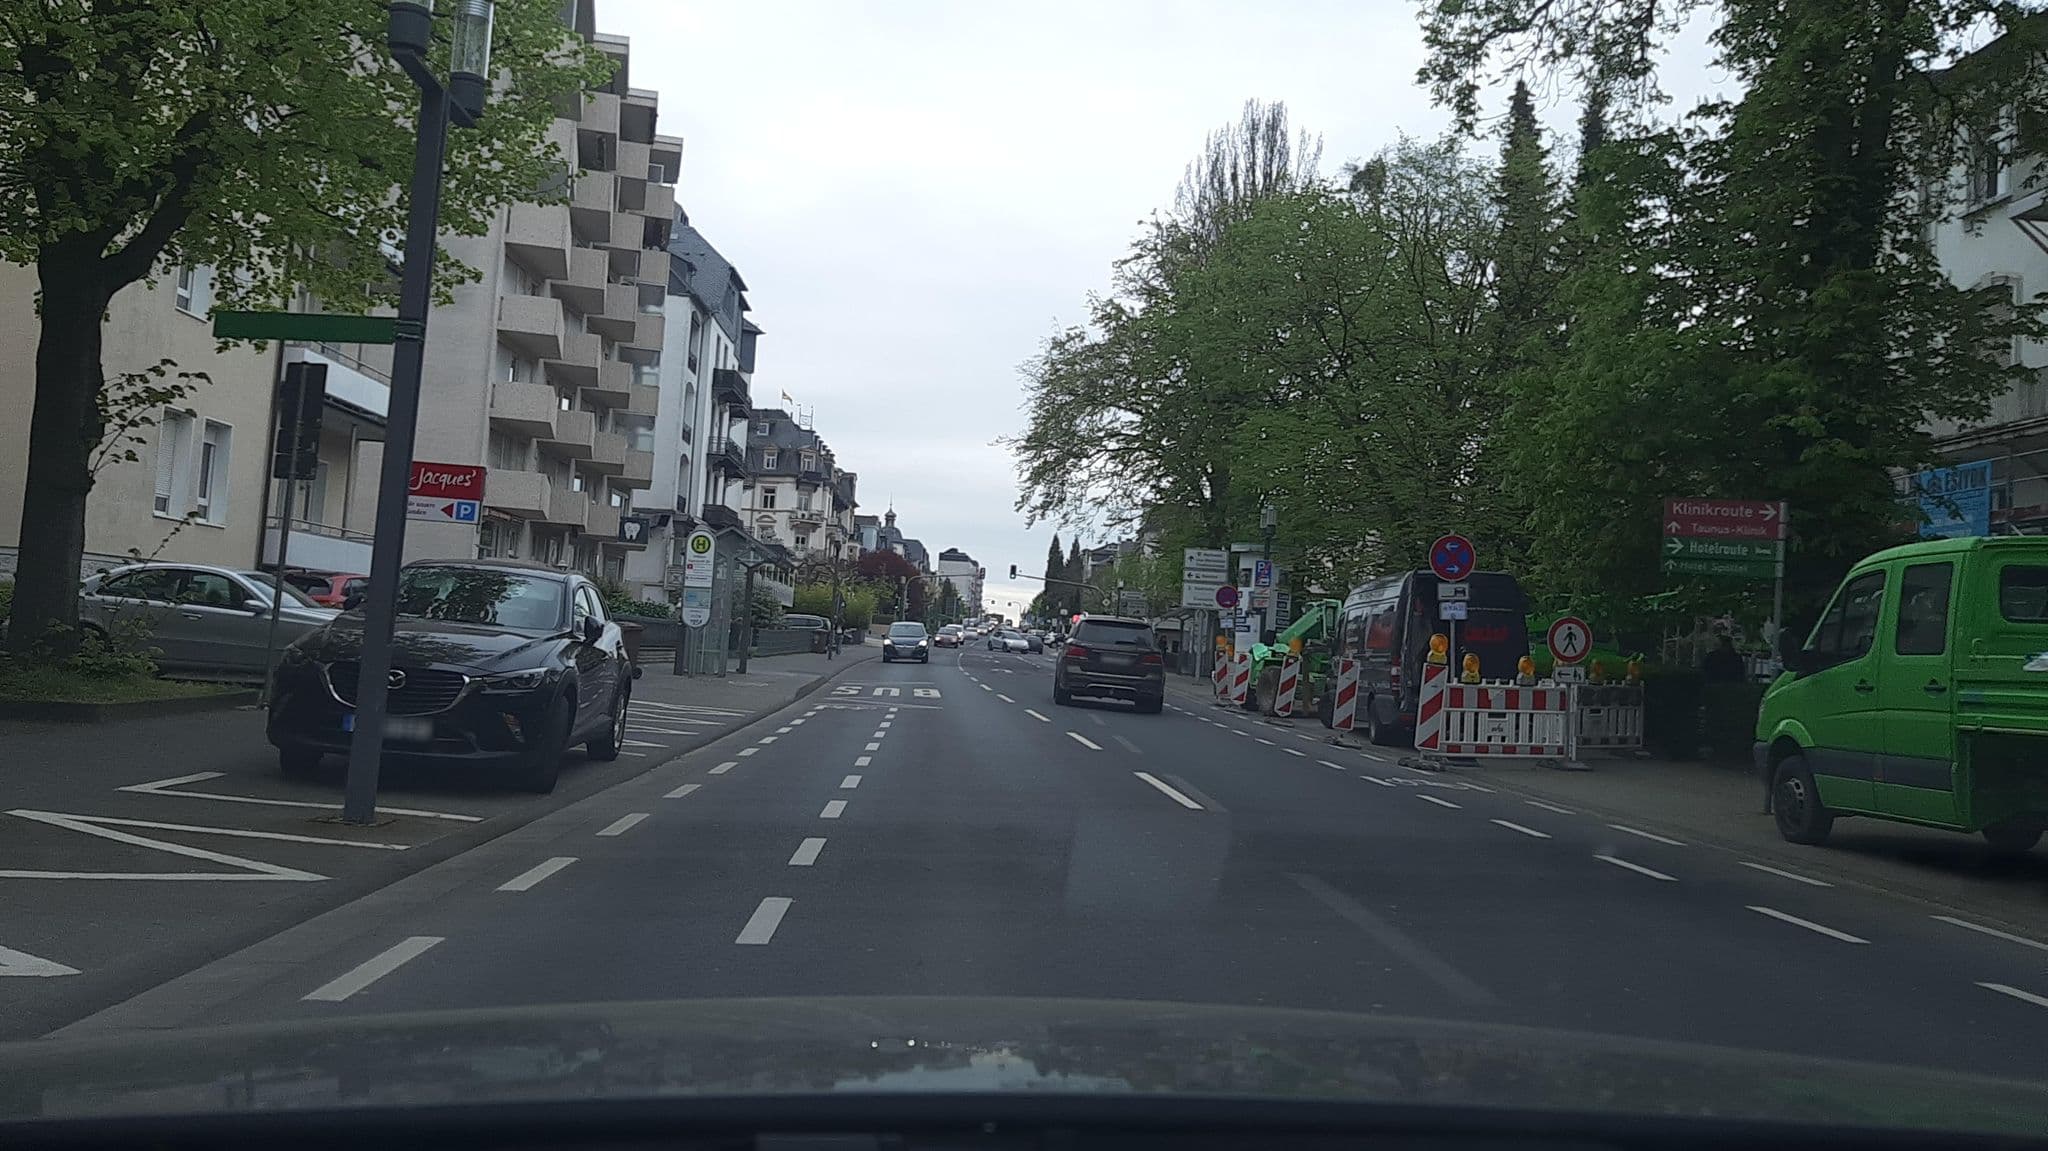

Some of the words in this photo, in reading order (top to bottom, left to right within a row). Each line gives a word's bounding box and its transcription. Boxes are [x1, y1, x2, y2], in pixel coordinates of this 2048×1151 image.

[408, 467, 476, 491] Jacques'
[460, 504, 471, 518] P
[1673, 502, 1753, 518] Klinikroute
[1691, 523, 1767, 536] Taunus-Klinik
[1690, 541, 1749, 556] Hotelroute
[831, 686, 941, 698] BUS
